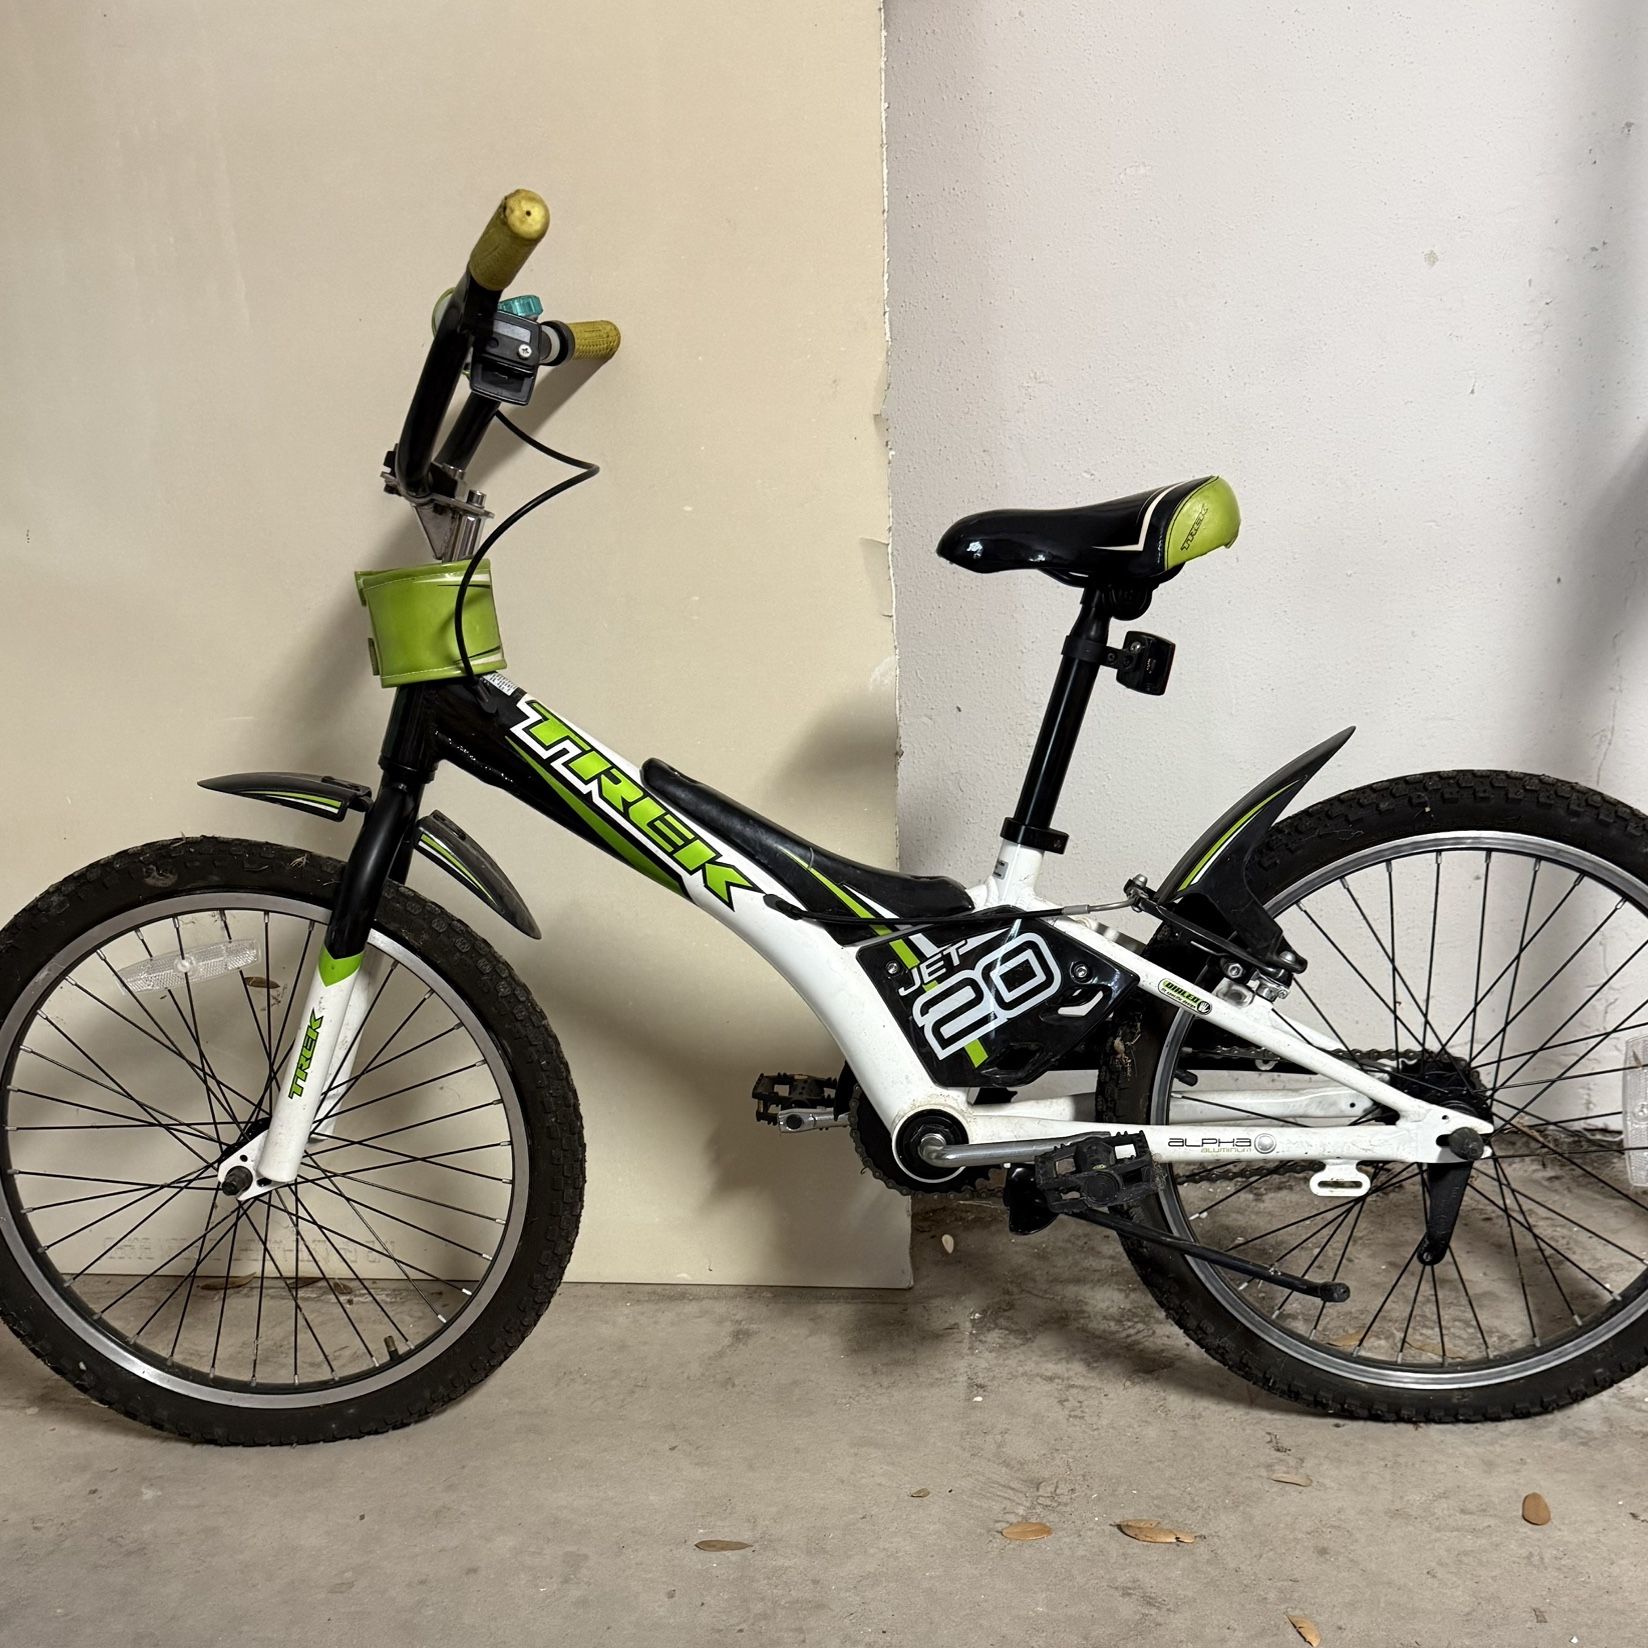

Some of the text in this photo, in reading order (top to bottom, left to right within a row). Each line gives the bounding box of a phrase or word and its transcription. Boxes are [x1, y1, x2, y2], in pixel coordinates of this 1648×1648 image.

[1180, 503, 1208, 551] TREK
[523, 699, 766, 911] TREK
[898, 939, 967, 996] JET
[912, 932, 1061, 1060] 20
[1165, 982, 1200, 1004] DIALED
[288, 1008, 324, 1099] TREK
